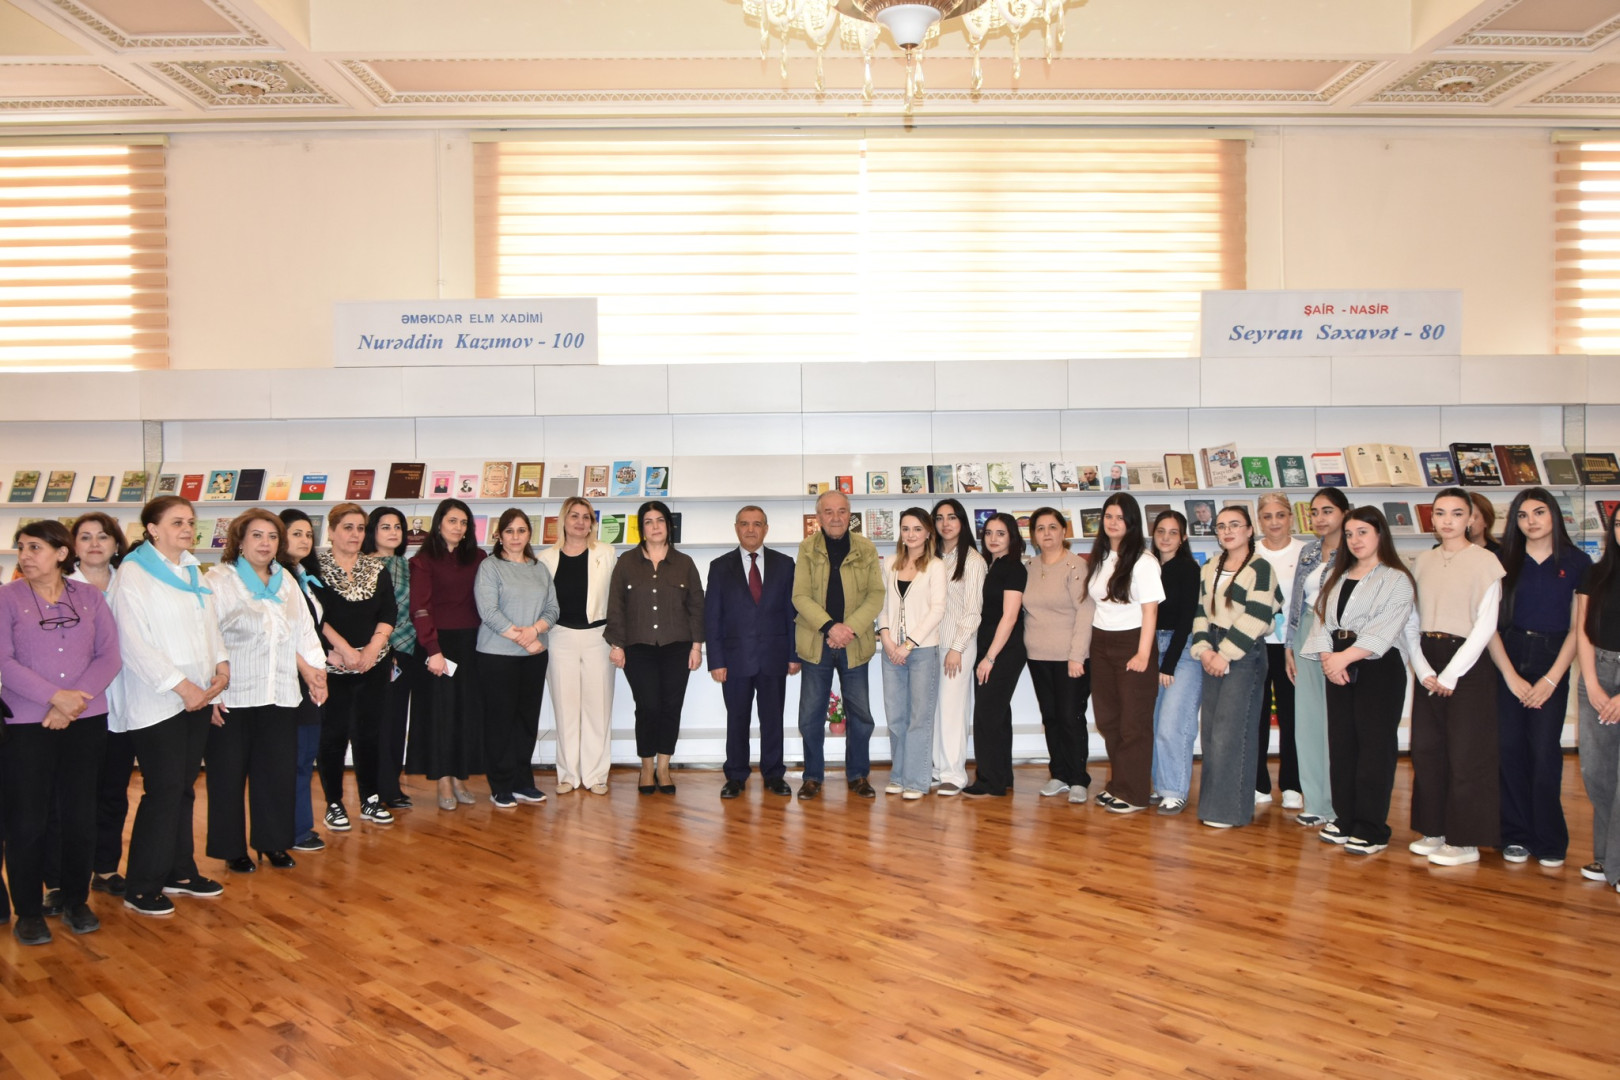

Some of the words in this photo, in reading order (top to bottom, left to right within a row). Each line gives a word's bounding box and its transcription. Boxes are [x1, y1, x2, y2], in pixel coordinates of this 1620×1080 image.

[401, 314, 463, 325] ƏMƏKDAR
[469, 313, 495, 324] ELM
[500, 311, 543, 324] XADİMİ
[1303, 303, 1335, 317] ŞAİR
[1349, 302, 1390, 315] NASİR
[357, 333, 444, 351] Nurəddin
[454, 333, 534, 351] Kazımov
[551, 332, 585, 349] 100
[1228, 324, 1304, 345] Seyran
[1316, 324, 1399, 341] Səxavət
[1419, 324, 1446, 341] 80
